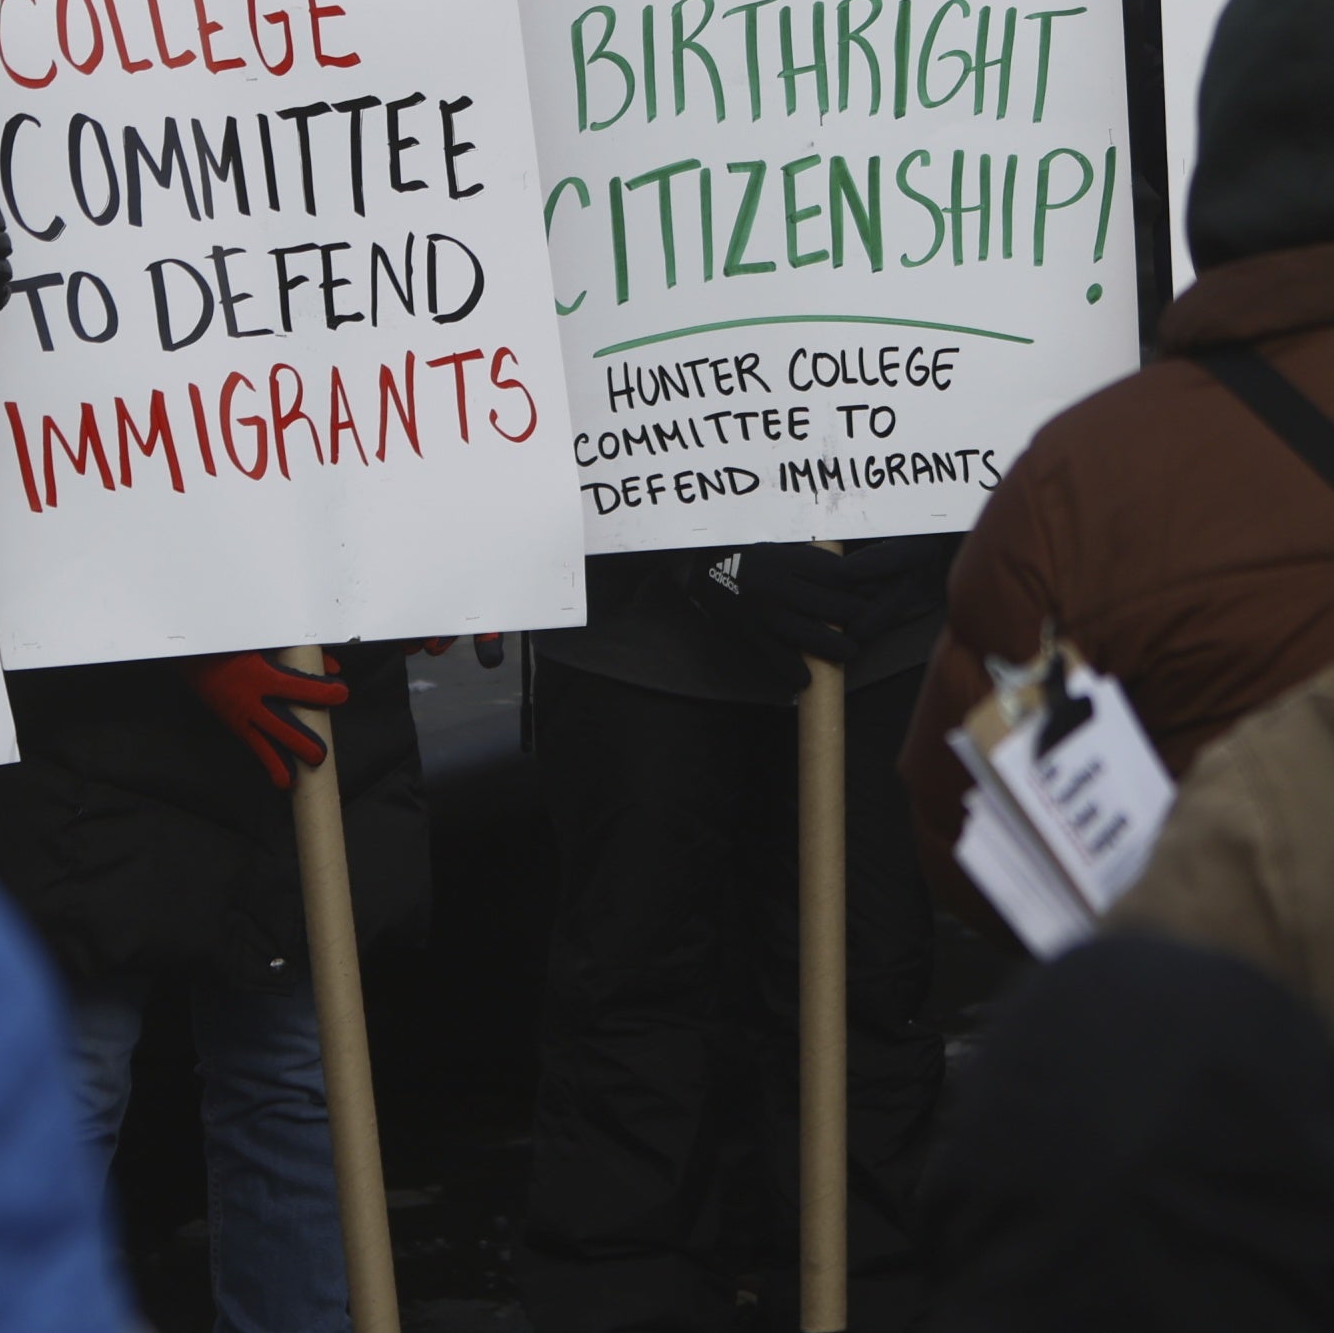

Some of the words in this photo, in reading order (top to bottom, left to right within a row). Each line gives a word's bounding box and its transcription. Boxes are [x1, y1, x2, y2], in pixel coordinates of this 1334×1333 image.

[543, 146, 1118, 317] CITIZENSHIP!
[9, 270, 120, 352] TO
[144, 232, 486, 353] DEFEND
[607, 351, 771, 413] HUNTER
[787, 346, 961, 392] COLLEGE
[4, 345, 538, 514] IMMIGRANTS
[572, 406, 811, 467] COMMITTEE
[836, 404, 897, 440] TO
[580, 466, 761, 515] DEFEND
[778, 447, 1003, 494] IMMIGRANTS
[709, 568, 739, 595] adidas
